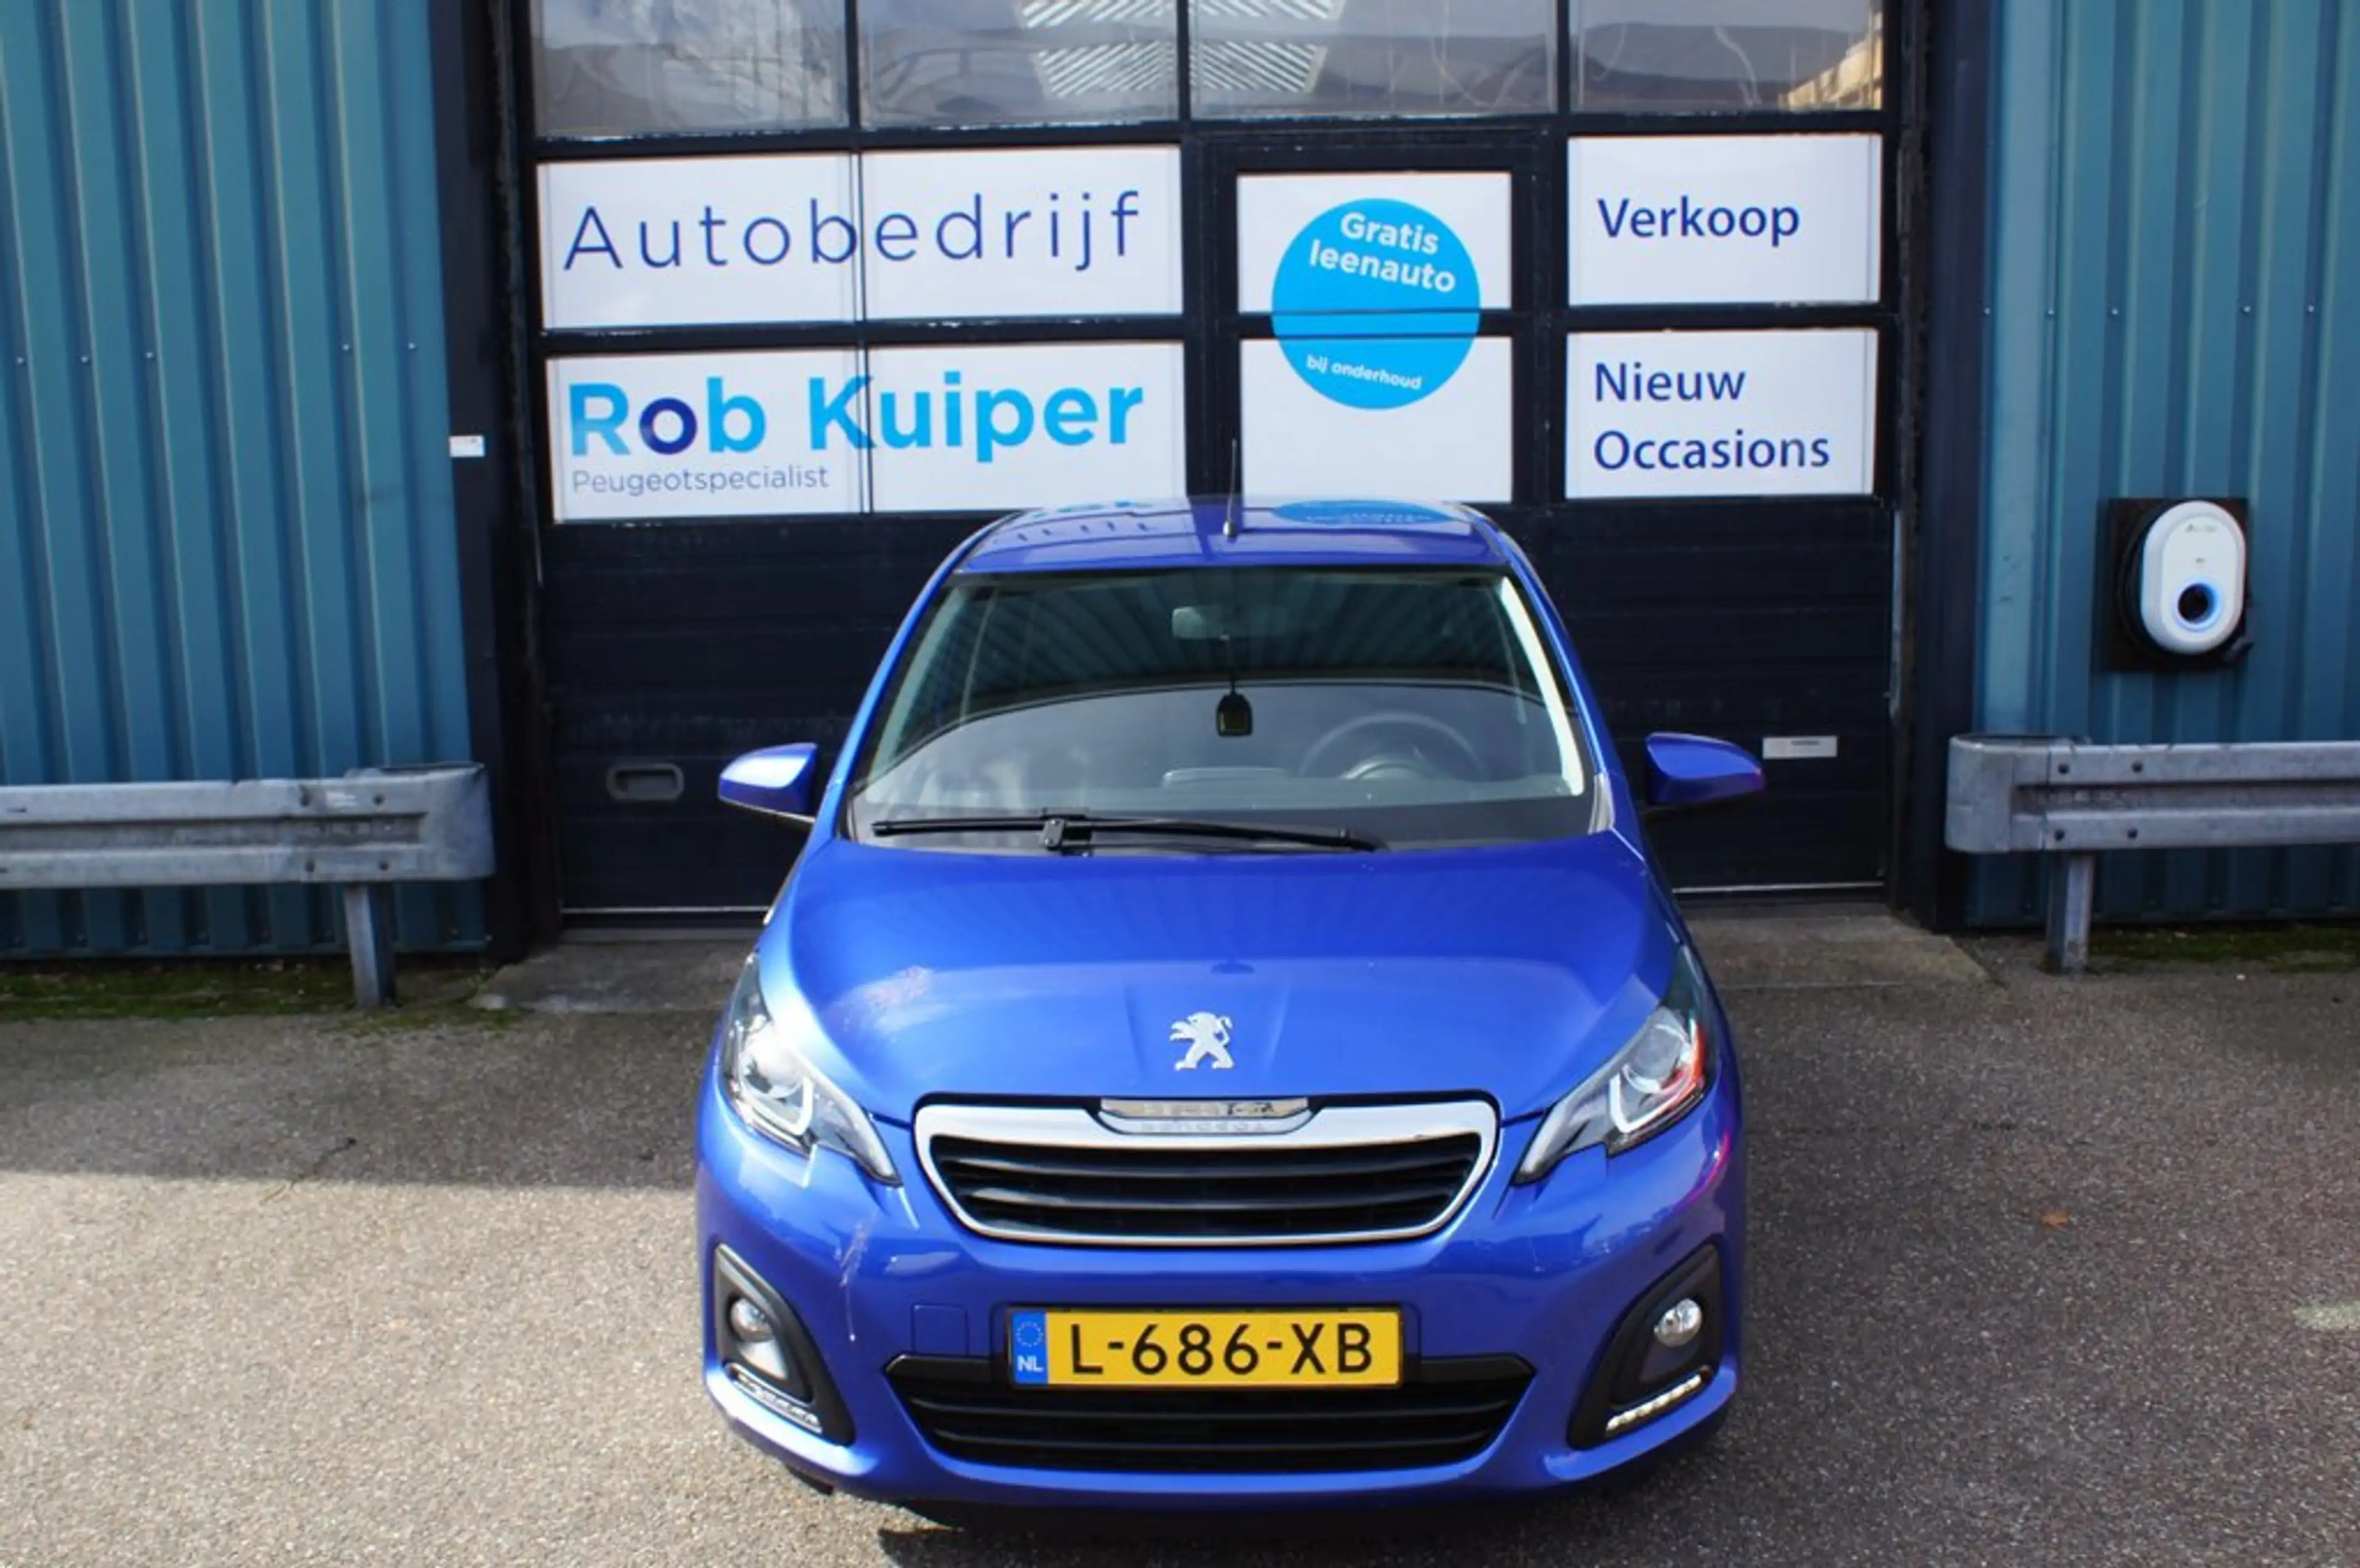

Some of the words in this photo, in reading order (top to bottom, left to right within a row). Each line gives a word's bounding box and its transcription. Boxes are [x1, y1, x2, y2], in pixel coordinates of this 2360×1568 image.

[562, 189, 1139, 272] Autobedrijf
[1340, 212, 1439, 256] Gratis
[1597, 195, 1800, 248] Verkoop
[1309, 238, 1457, 292] leenauto
[1306, 353, 1328, 374] bij
[1331, 361, 1422, 391] onderhoud
[1595, 361, 1746, 402] Nieuw
[568, 375, 767, 457] Rob
[808, 369, 1144, 464] Kuiper
[1594, 428, 1830, 471] Occasions
[572, 465, 829, 498] Peugeotspecialist
[1018, 1356, 1043, 1372] NL
[1071, 1323, 1372, 1376] L-686-XB
